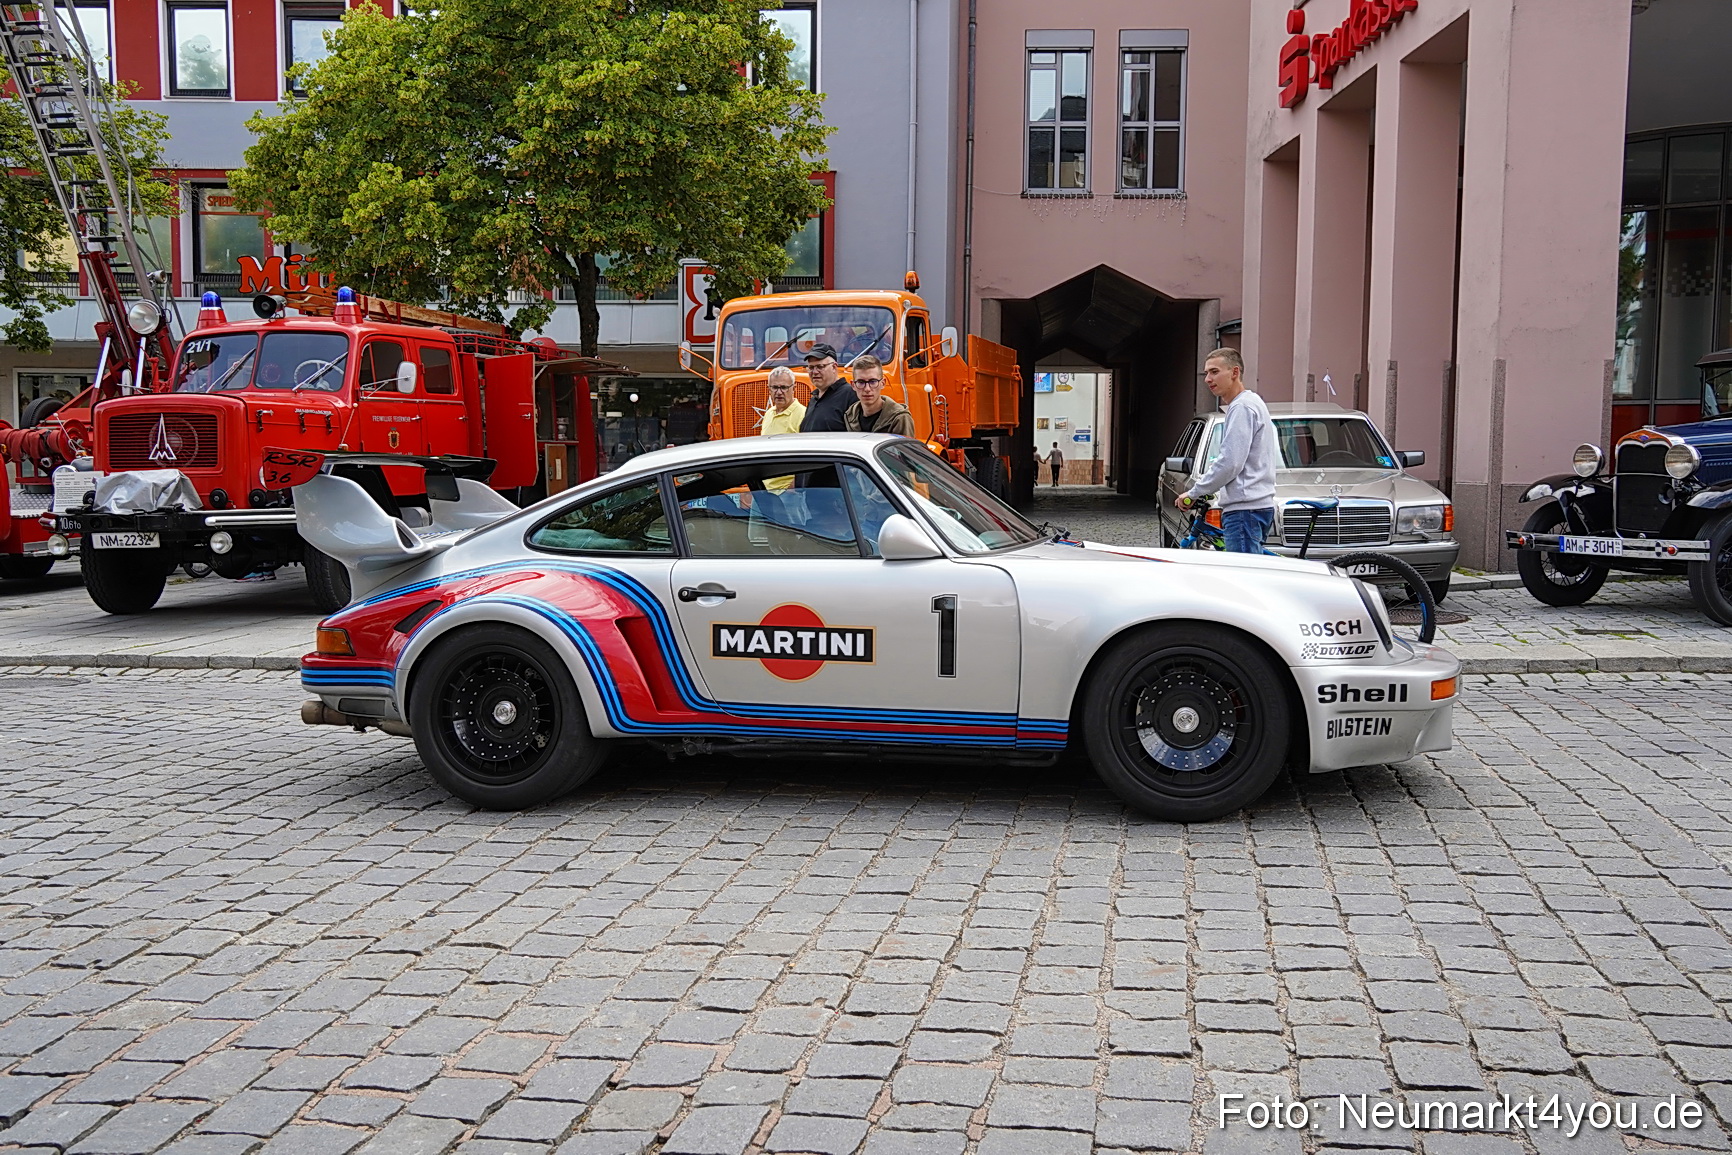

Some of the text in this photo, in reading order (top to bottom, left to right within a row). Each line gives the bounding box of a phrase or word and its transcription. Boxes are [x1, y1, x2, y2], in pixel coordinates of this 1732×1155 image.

[186, 340, 212, 354] 21/1
[264, 451, 318, 468] RSR
[265, 470, 292, 484] 3.6
[1565, 538, 1578, 552] AM
[1583, 539, 1590, 552] F
[931, 594, 958, 678] 1
[1299, 619, 1362, 637] BOSCH
[720, 628, 865, 657] MARTINI
[1320, 645, 1376, 656] DUNLOP
[1317, 683, 1408, 704] Shell
[1326, 717, 1393, 740] BILSTEIN
